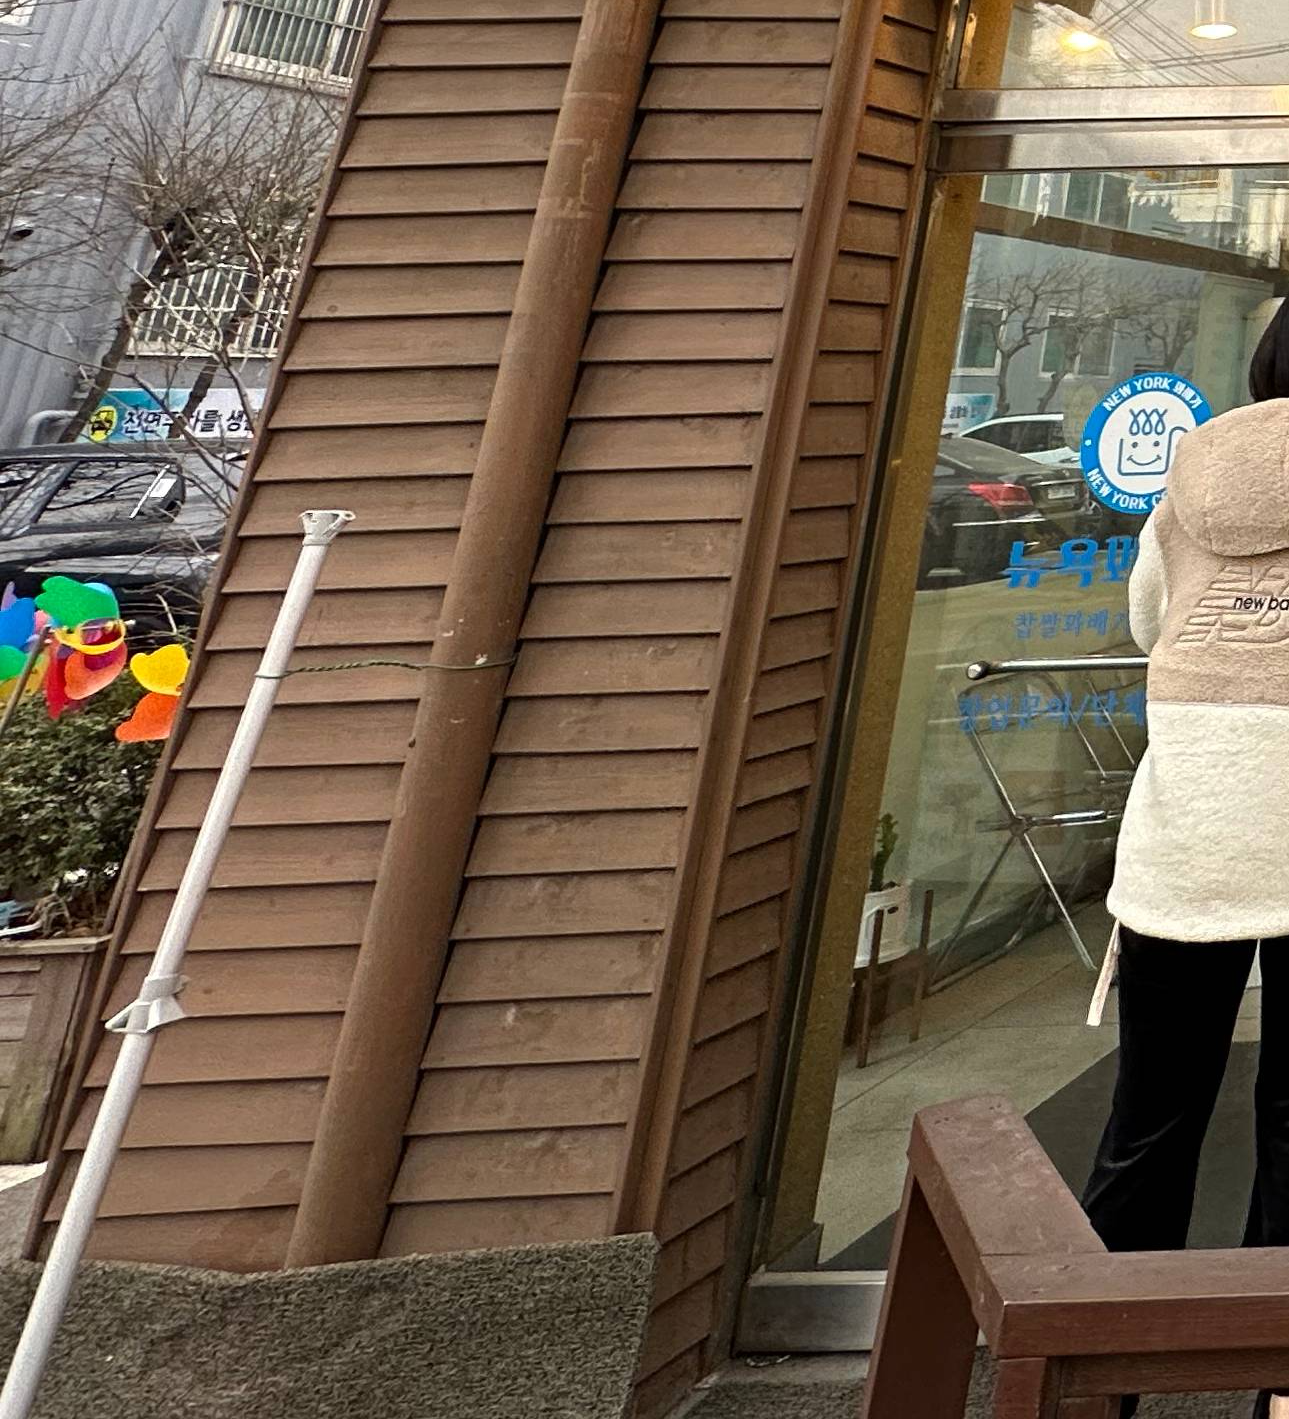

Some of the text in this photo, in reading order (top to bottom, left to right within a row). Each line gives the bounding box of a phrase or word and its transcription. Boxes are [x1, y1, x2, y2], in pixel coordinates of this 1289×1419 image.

[1102, 383, 1132, 412] NEW
[1133, 376, 1174, 392] YORK
[1087, 467, 1113, 498] NEW
[1112, 491, 1149, 510] YORK
[1234, 595, 1267, 611] new
